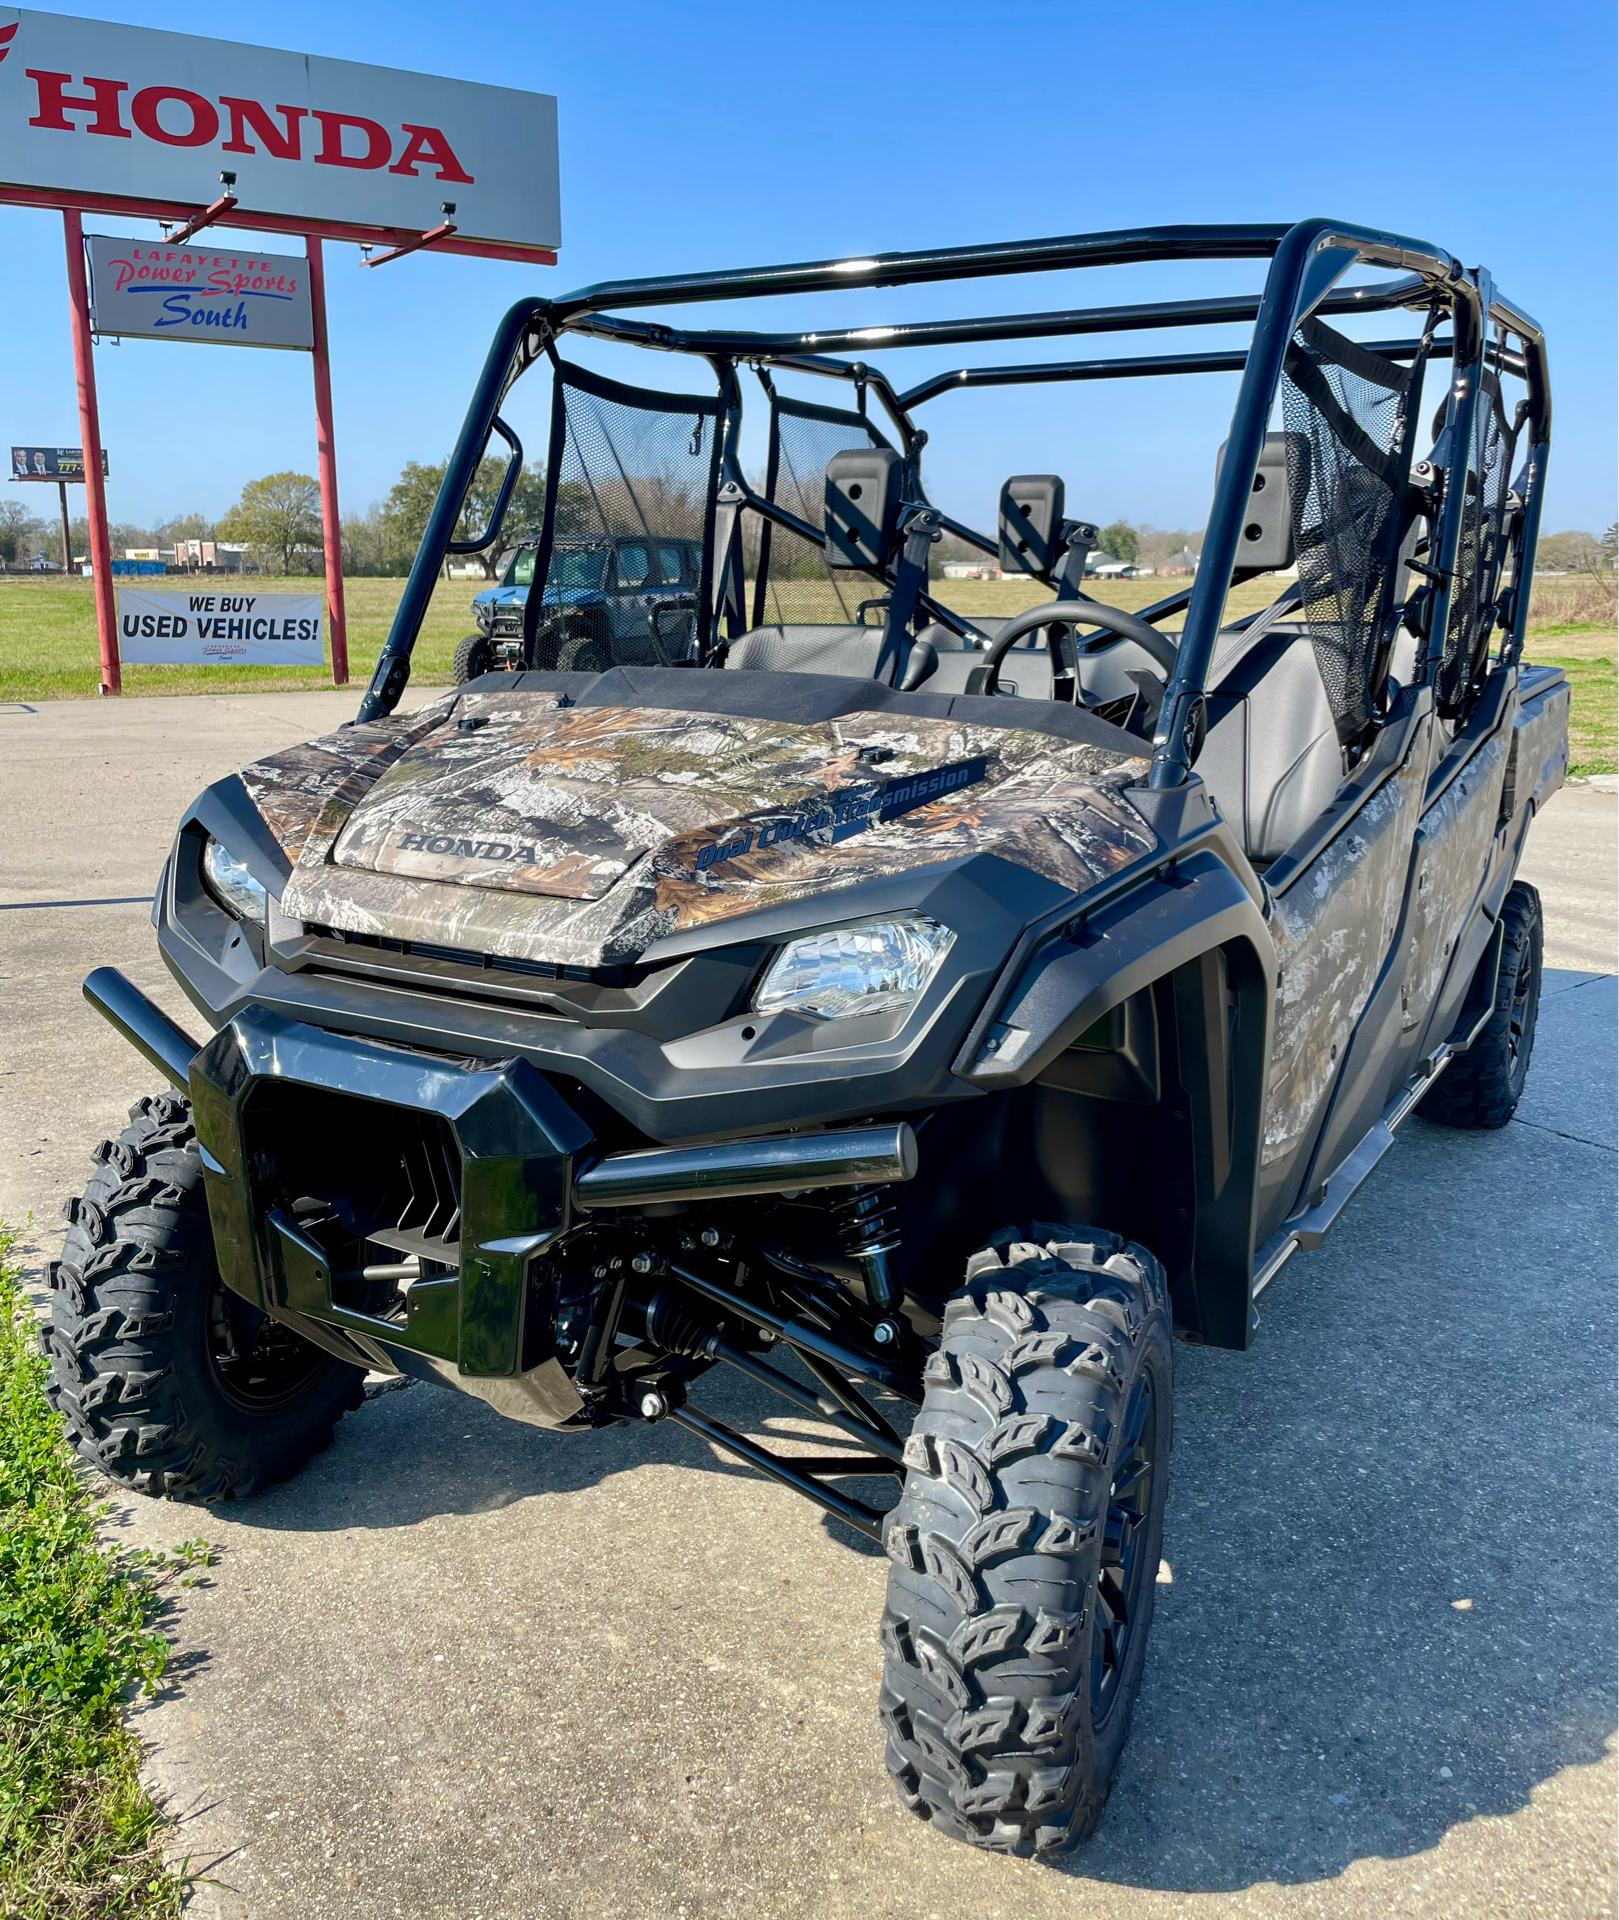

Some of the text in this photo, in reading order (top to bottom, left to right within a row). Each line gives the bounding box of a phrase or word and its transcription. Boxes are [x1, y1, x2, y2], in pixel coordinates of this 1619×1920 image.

[25, 69, 475, 184] HONDA
[132, 248, 272, 272] LAFAYETTE
[107, 259, 297, 297] Power Sports
[153, 294, 247, 329] South
[189, 596, 257, 613] WE BUY
[123, 615, 319, 640] USED VEHICLES!
[694, 768, 969, 870] Dual Clutch Transmission
[396, 832, 538, 865] HONDA
